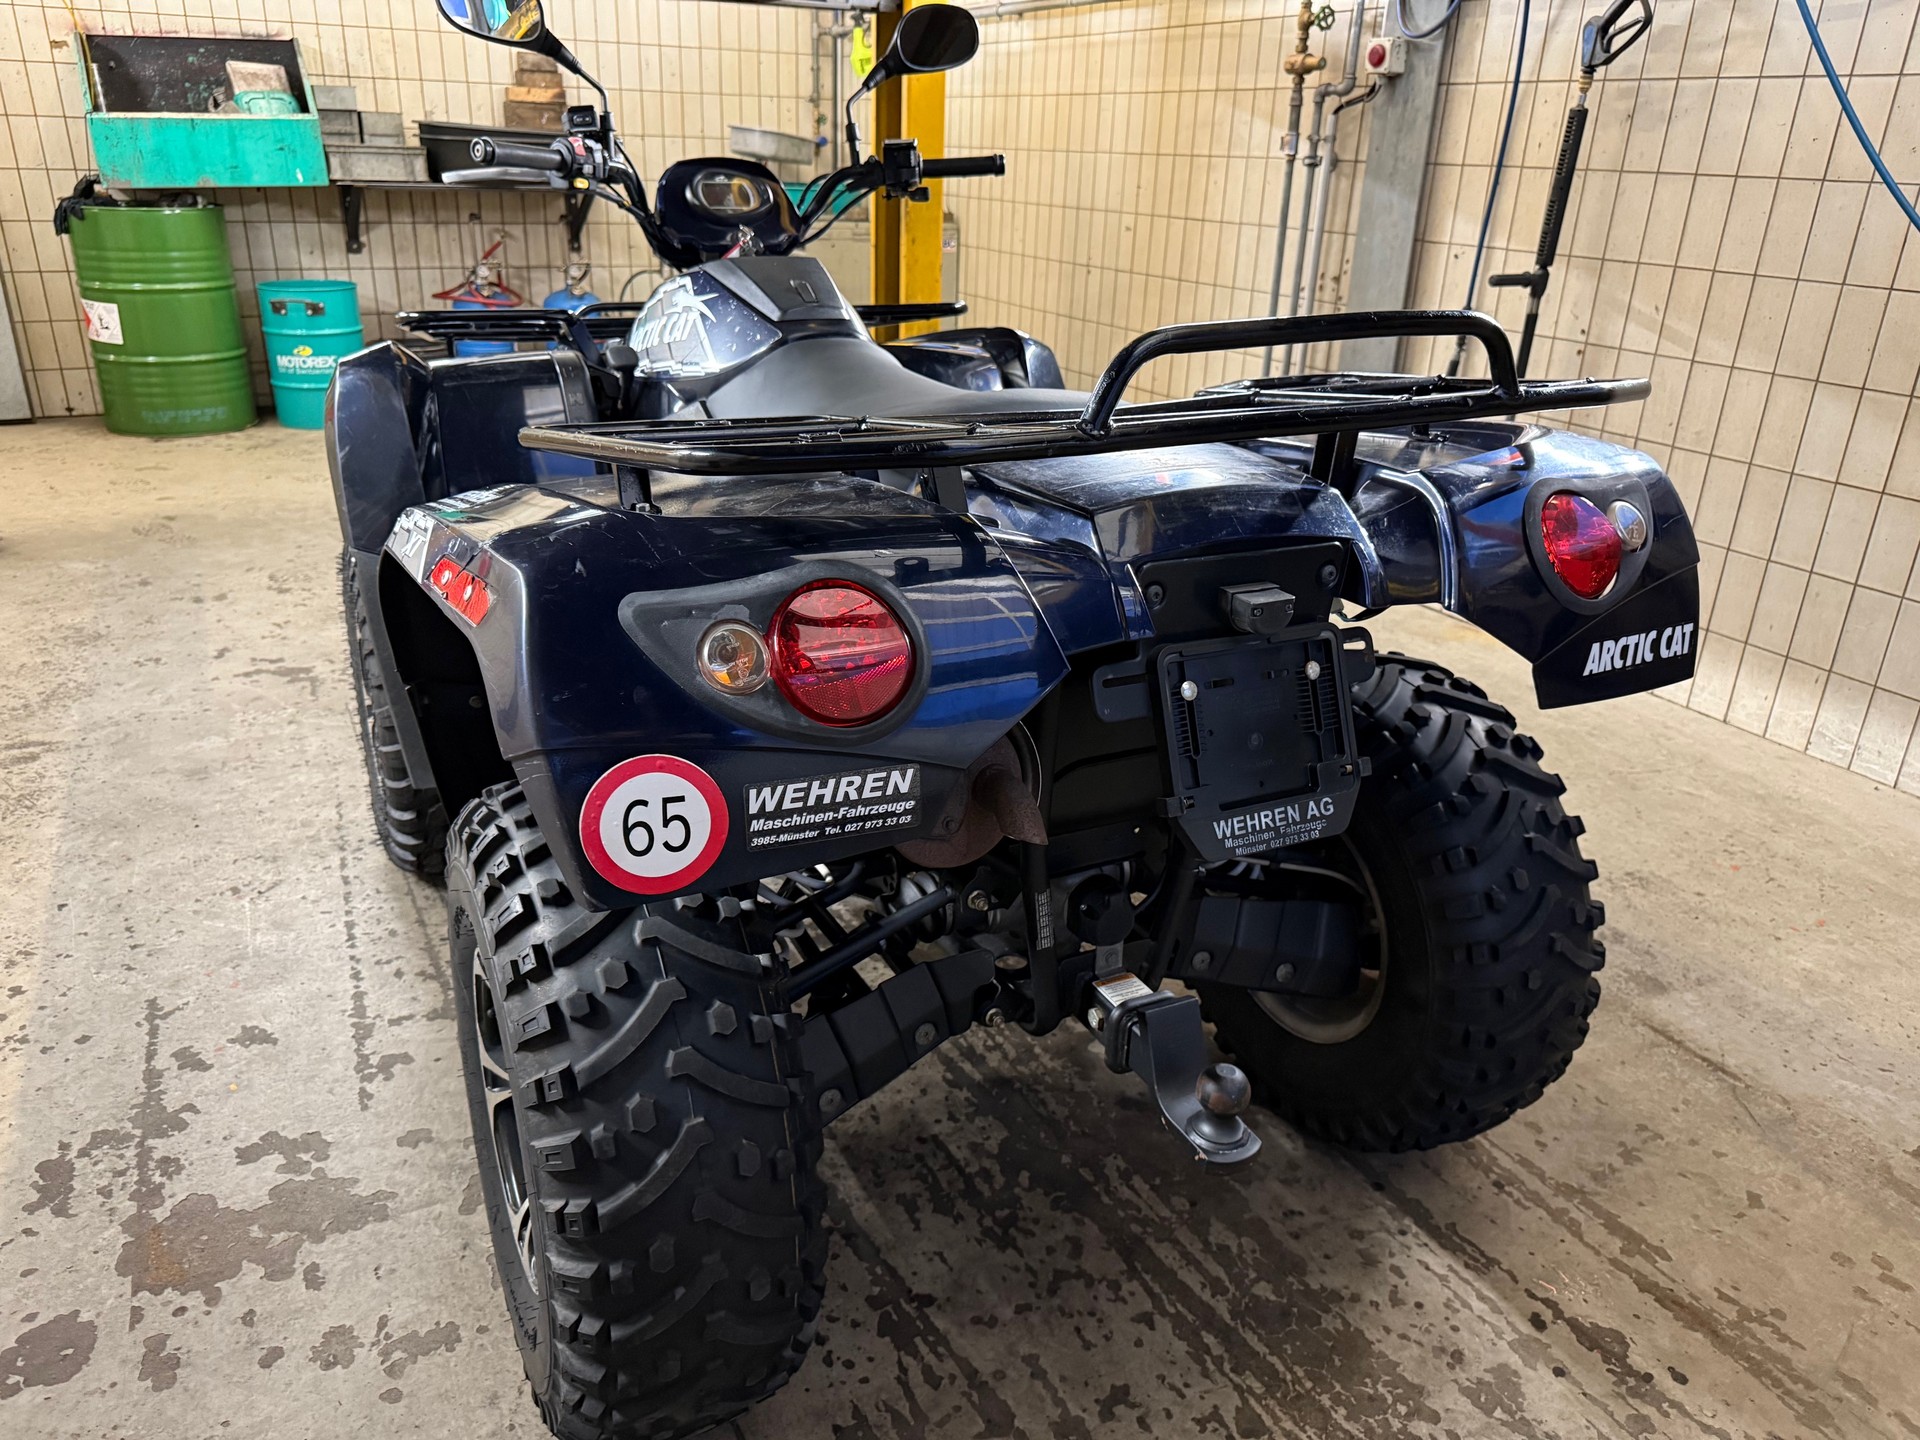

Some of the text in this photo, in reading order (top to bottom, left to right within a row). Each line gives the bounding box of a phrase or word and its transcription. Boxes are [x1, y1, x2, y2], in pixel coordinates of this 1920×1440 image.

[663, 311, 700, 344] CAT
[276, 355, 338, 368] MOTOREX
[1582, 622, 1694, 676] ARCTIC CAT
[748, 768, 914, 815] WEHREN
[622, 795, 691, 857] 65
[750, 800, 915, 832] Maschinen-Fahrzeuge
[751, 815, 913, 847] 3985-Münster Tel. 027 973 33 03
[1213, 797, 1335, 840] WEHREN AG
[1224, 831, 1275, 849] Maschinen
[1235, 830, 1320, 857] Münster 027 973 33 03
